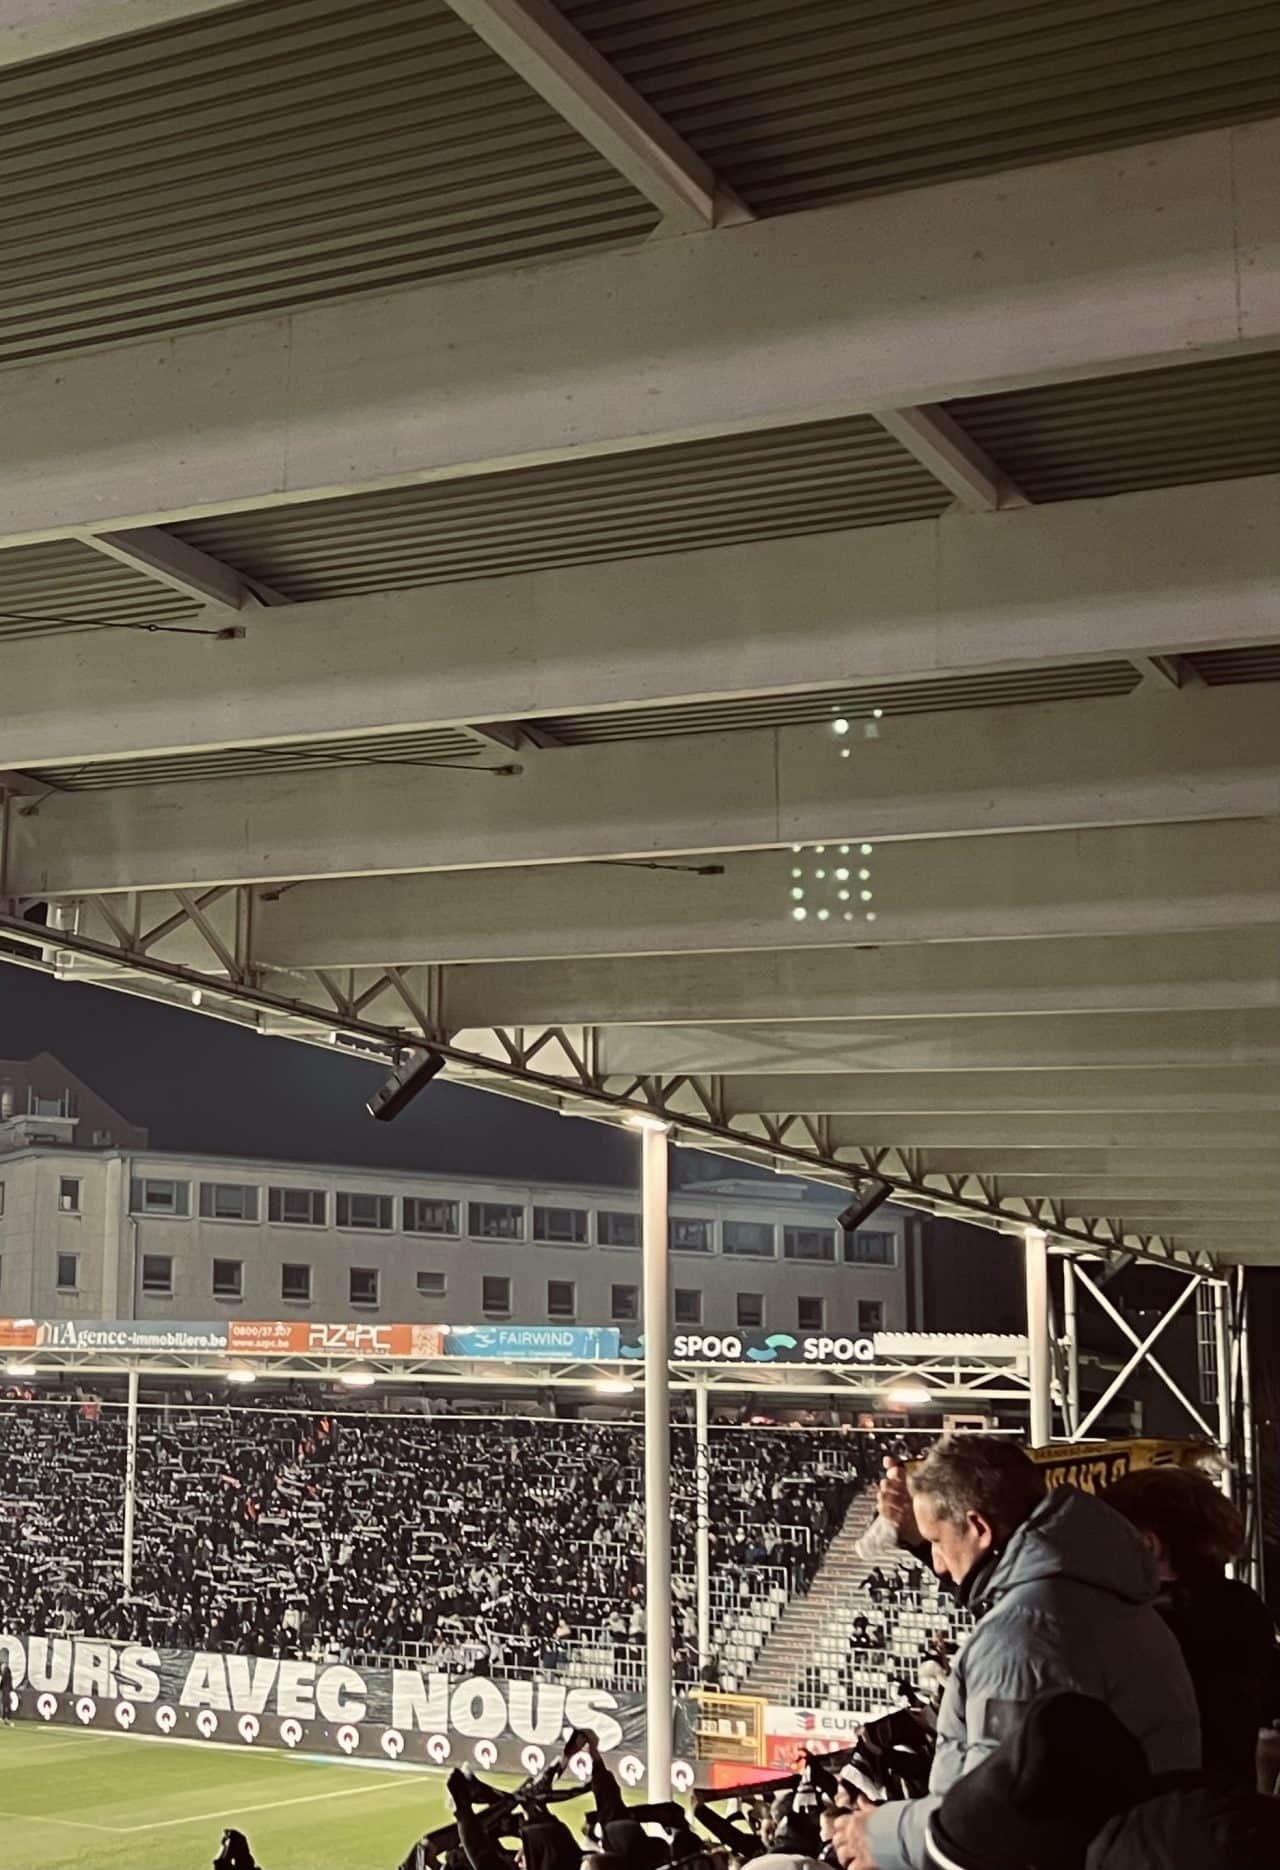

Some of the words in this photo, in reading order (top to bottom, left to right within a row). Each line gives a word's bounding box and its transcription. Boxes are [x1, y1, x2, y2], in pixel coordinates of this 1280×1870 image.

[499, 1331, 574, 1345] FAIRWIND
[673, 1335, 742, 1358] SPOQ
[803, 1337, 875, 1360] SPOQ
[179, 1651, 368, 1724] AVEC
[392, 1667, 625, 1753] NOUS
